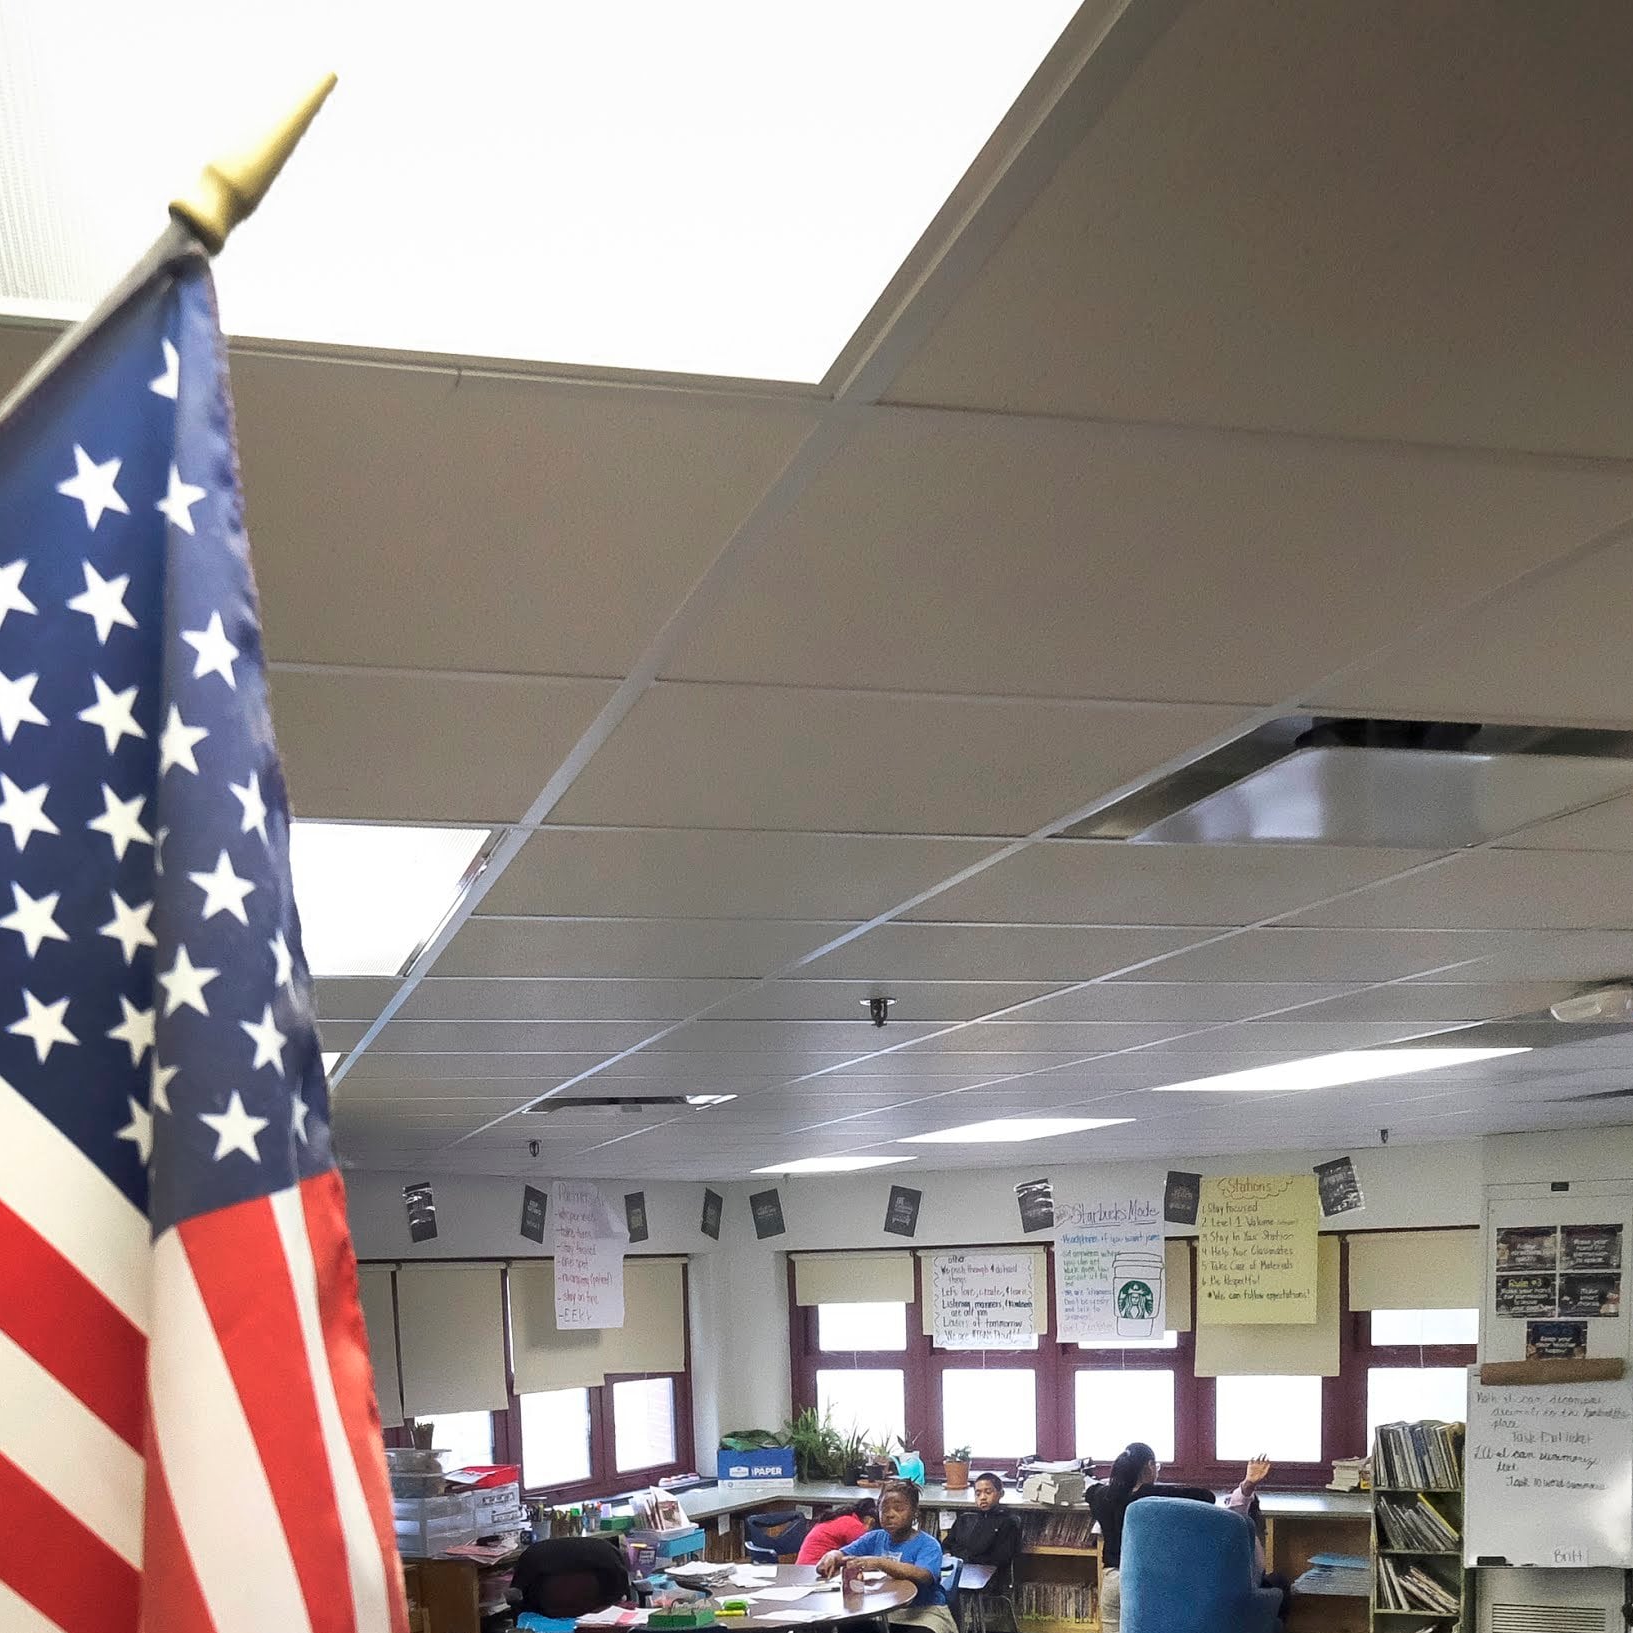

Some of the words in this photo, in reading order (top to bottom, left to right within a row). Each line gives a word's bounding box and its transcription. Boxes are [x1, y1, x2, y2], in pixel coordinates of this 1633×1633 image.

[1227, 1177, 1271, 1193] Stations
[1070, 1202, 1127, 1224] Starbucks
[1128, 1200, 1161, 1222] Mode
[1208, 1202, 1224, 1216] Stay
[1226, 1201, 1258, 1213] focused
[1211, 1218, 1232, 1228] Level
[1236, 1216, 1243, 1228] 1
[1248, 1216, 1274, 1226] Volume
[1210, 1231, 1229, 1244] Stay
[1262, 1229, 1295, 1241] Station
[1211, 1246, 1229, 1258] Help
[1232, 1247, 1248, 1256] Your
[1250, 1243, 1294, 1256] Classmates
[1210, 1261, 1227, 1271] Take
[1249, 1260, 1256, 1270] of
[1260, 1260, 1294, 1271] Materials
[1228, 1292, 1241, 1300] can
[1244, 1289, 1264, 1300] follow
[754, 1466, 784, 1477] PAPER
